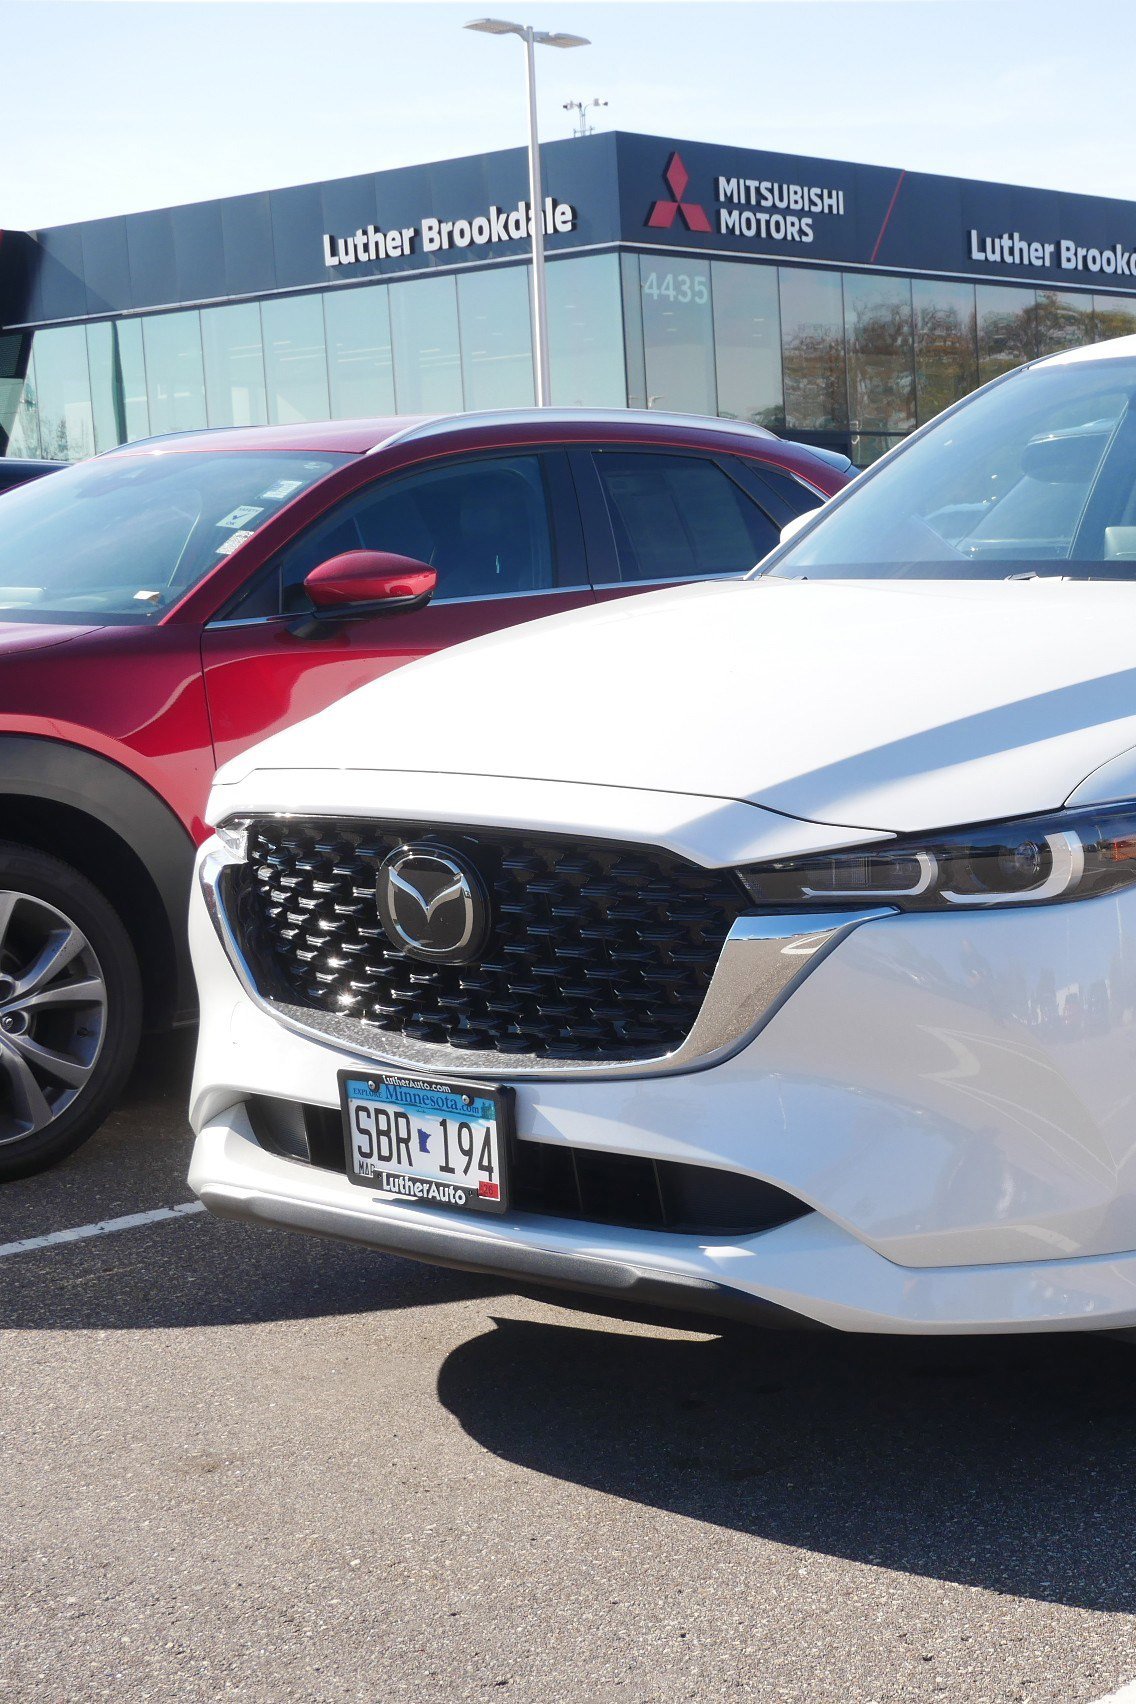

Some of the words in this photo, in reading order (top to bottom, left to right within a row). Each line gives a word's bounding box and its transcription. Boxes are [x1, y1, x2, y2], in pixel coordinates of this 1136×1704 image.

[718, 176, 844, 215] MITSUBISHI
[719, 208, 814, 243] MOTORS
[323, 224, 415, 267] Luther
[970, 229, 1055, 267] Luther
[644, 272, 708, 305] 4435
[382, 1074, 451, 1093] LutherAuto.com
[354, 1104, 414, 1168] SBR
[439, 1118, 495, 1182] 194
[382, 1172, 466, 1206] LutherAuto
